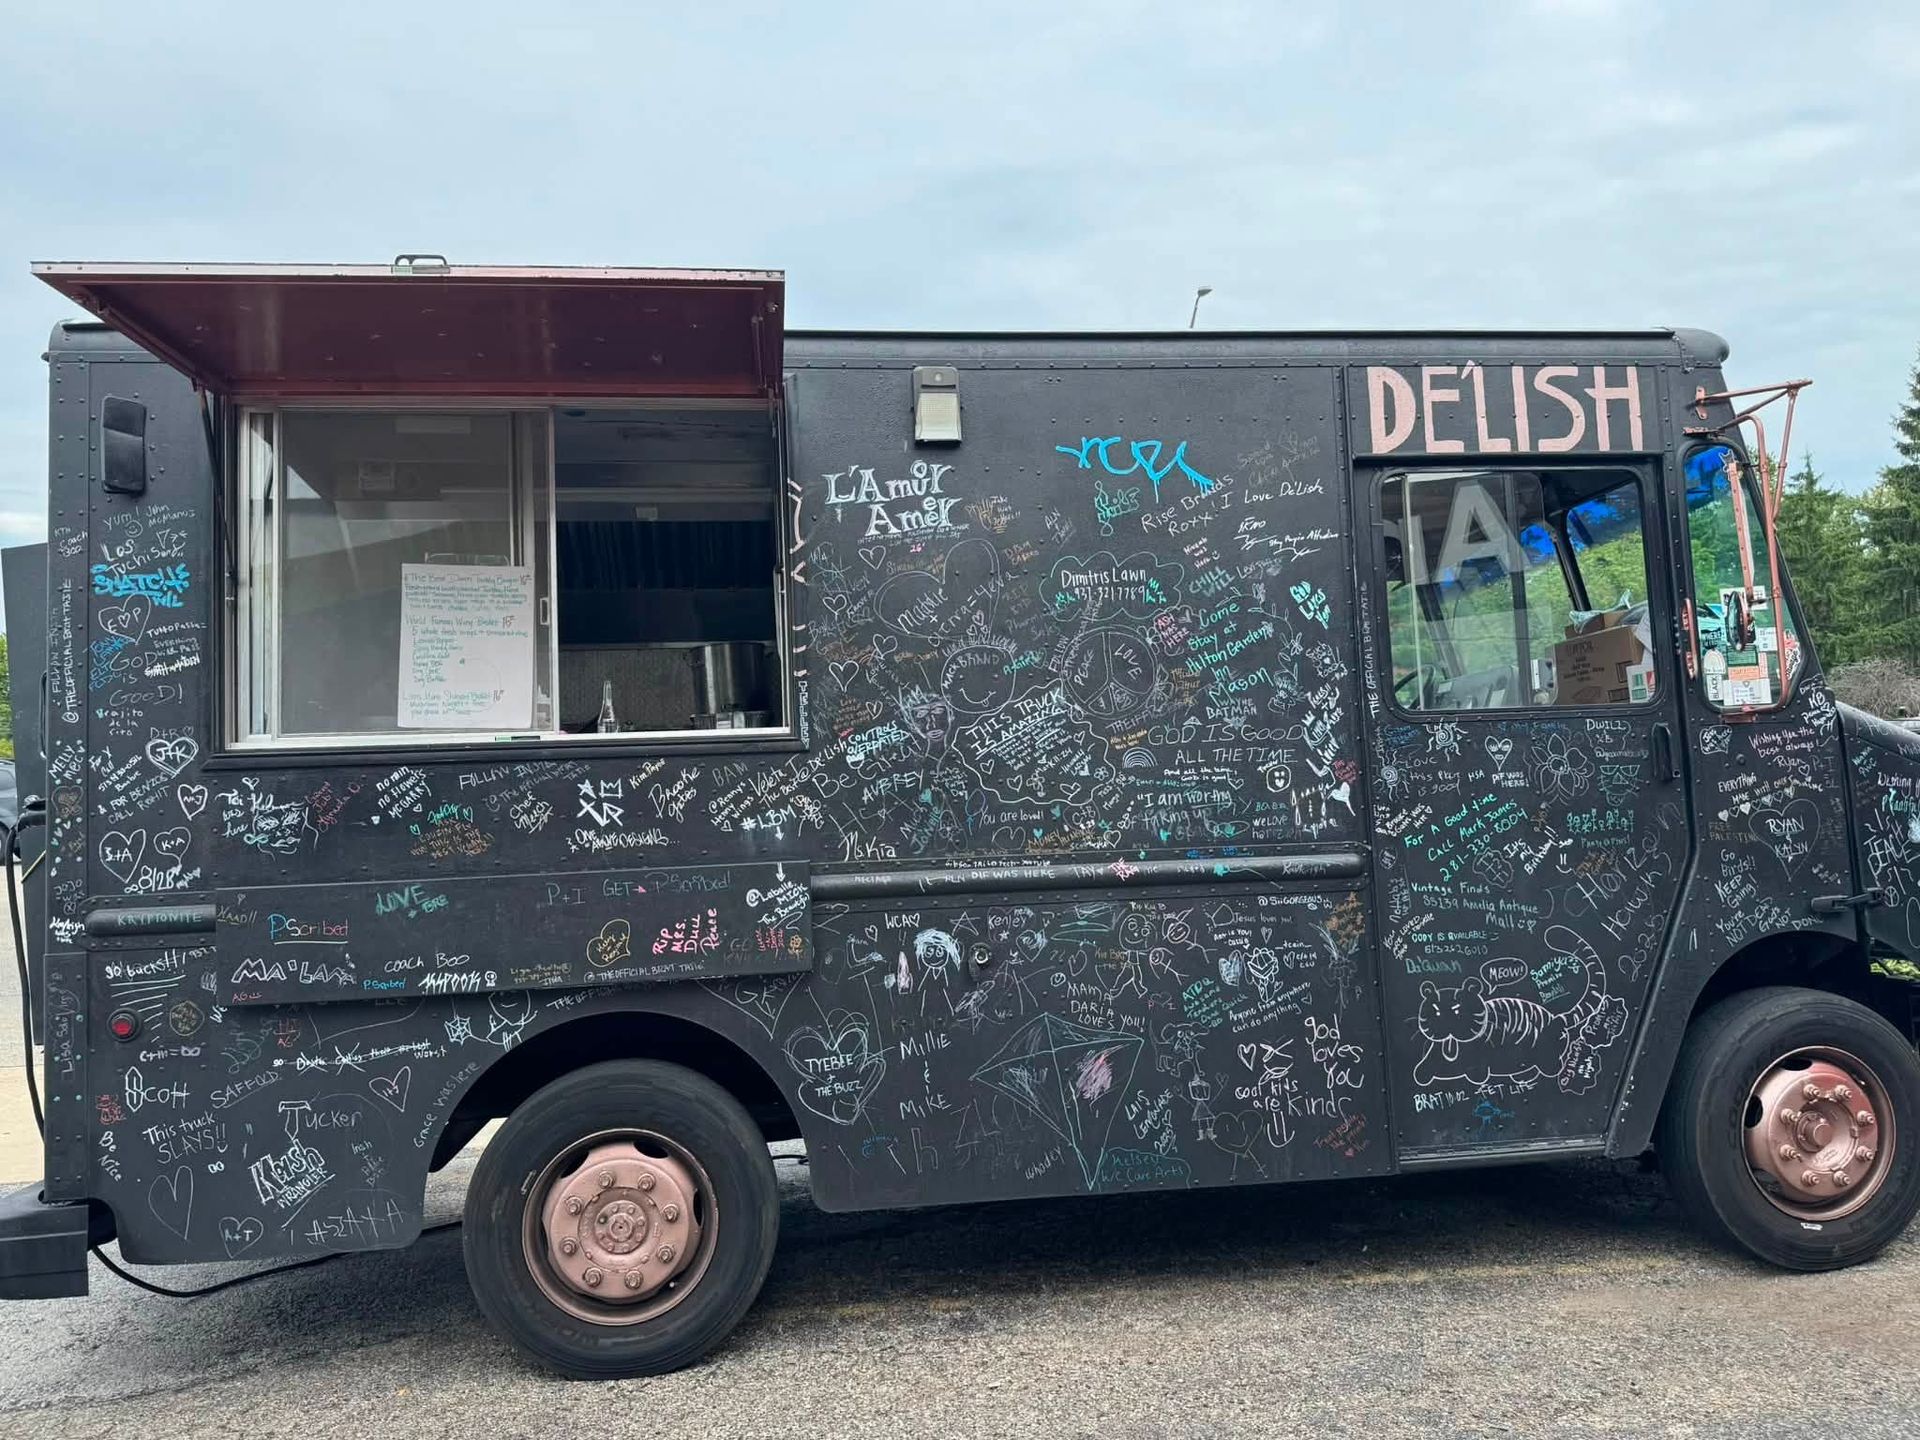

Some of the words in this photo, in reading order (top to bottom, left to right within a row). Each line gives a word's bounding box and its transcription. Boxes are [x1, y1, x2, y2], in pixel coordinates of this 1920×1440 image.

[1366, 360, 1643, 454] DE'LISH
[1061, 569, 1110, 589] Dimitris
[1112, 567, 1147, 583] Lawn
[1200, 602, 1241, 630] Come
[1185, 647, 1228, 674] Hilton
[1208, 667, 1274, 707] Mason
[1711, 674, 1720, 700] BLACK
[965, 713, 1013, 741] THIS
[1013, 688, 1062, 716] TRUCK
[970, 735, 997, 756] IS
[1000, 705, 1065, 742] AMAZING
[1148, 725, 1197, 746] GOD
[1202, 723, 1235, 742] IS
[1241, 724, 1303, 741] GOOD
[1175, 749, 1206, 765] ALL
[1213, 747, 1242, 762] THE
[1246, 747, 1299, 763] TIME
[1000, 810, 1018, 822] are
[1444, 804, 1470, 827] Good
[1765, 817, 1806, 833] RYAN
[1459, 817, 1487, 842] Mark
[993, 867, 1018, 879] WAS
[1023, 866, 1056, 879] HERE
[1411, 882, 1452, 896] Vintage
[1460, 881, 1491, 894] Finds
[117, 912, 203, 927] KRYPTONITE
[1499, 899, 1540, 918] Antique
[1485, 912, 1514, 930] Mall
[1489, 965, 1525, 980] MEOW!
[1232, 1022, 1249, 1034] can
[1250, 1018, 1262, 1027] do
[1262, 1003, 1302, 1023] anything
[1304, 1013, 1341, 1045] god
[1413, 1092, 1444, 1113] BRAT
[179, 1112, 216, 1131] truck
